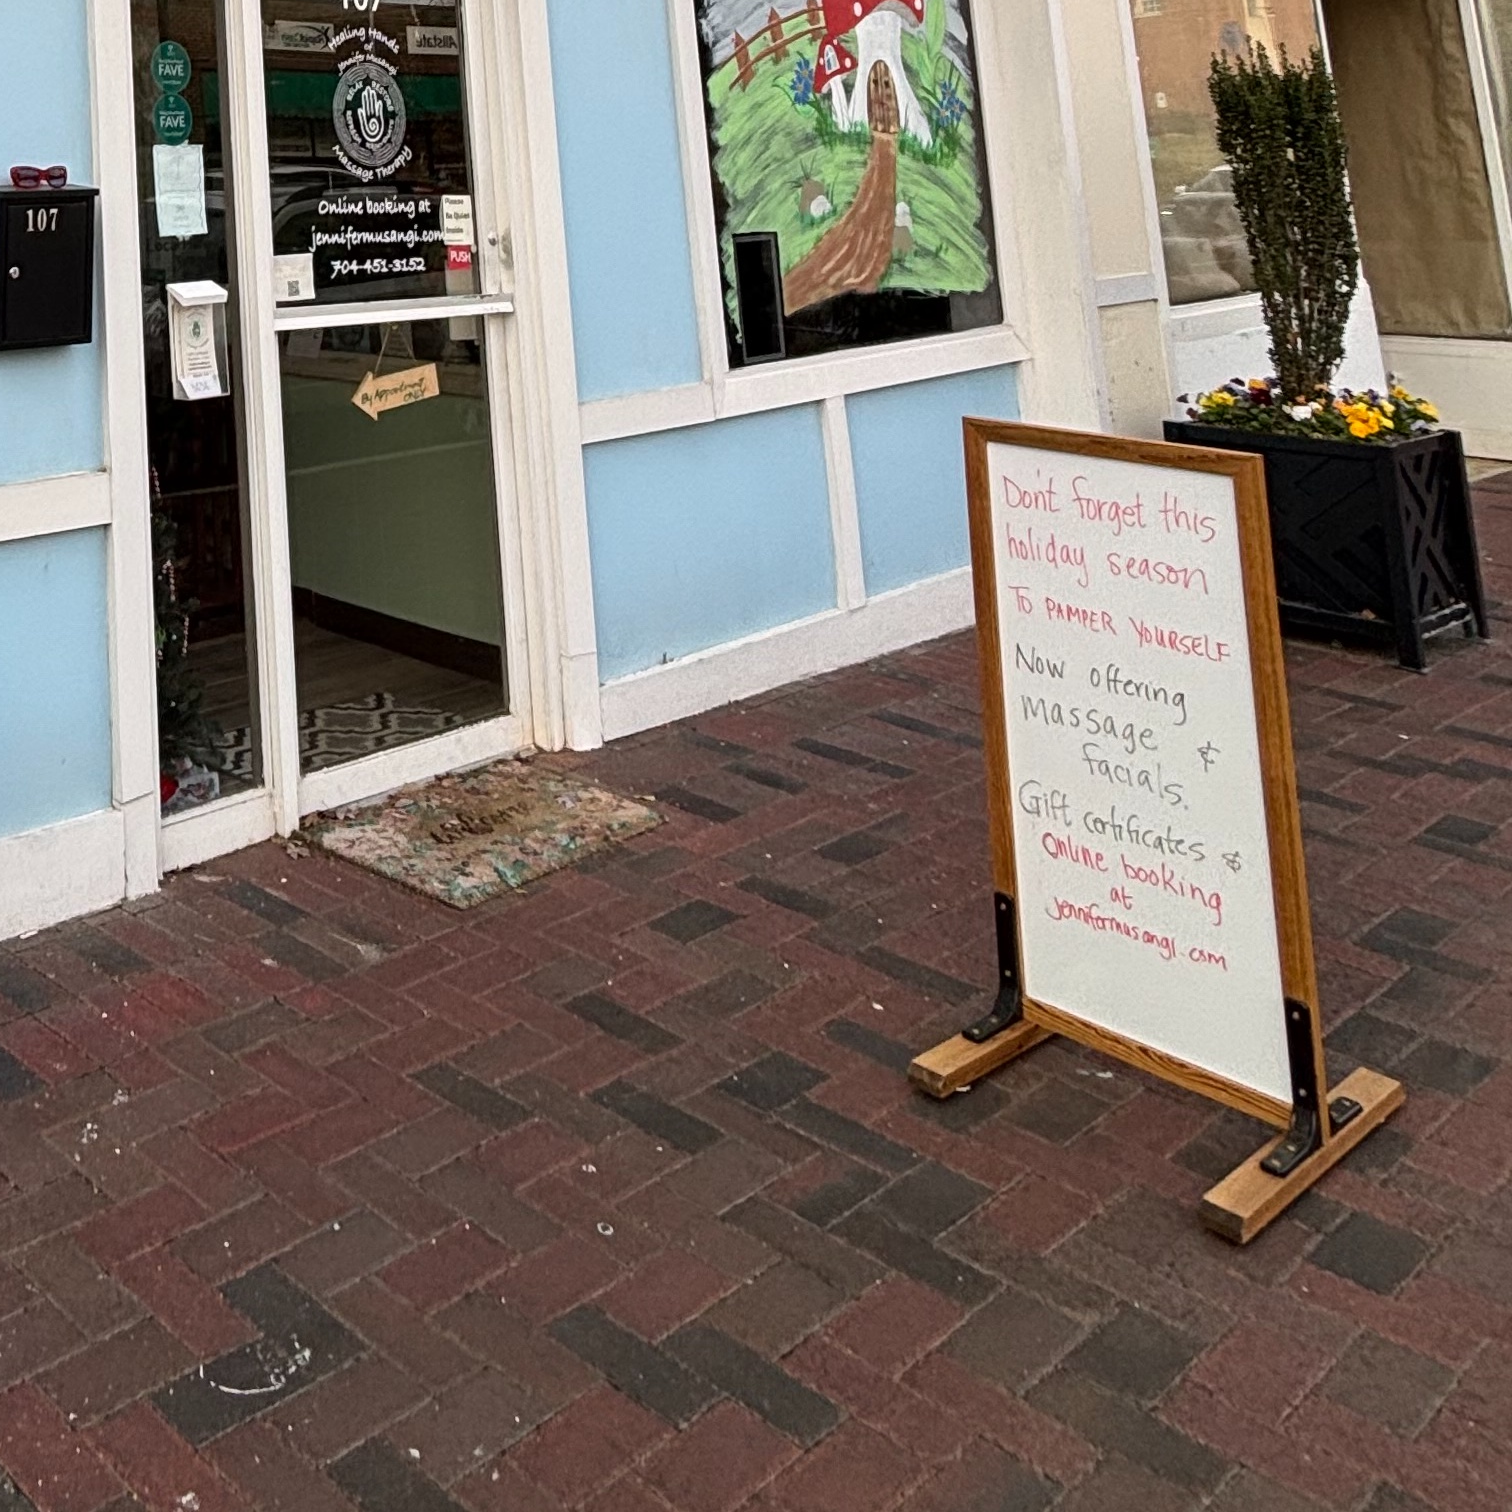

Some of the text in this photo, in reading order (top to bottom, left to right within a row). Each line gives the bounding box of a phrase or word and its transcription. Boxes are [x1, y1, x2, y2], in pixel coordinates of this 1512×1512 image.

[327, 24, 366, 51] Healing
[368, 26, 400, 55] Hands
[363, 40, 375, 52] of
[158, 63, 184, 77] FAVE
[159, 115, 186, 128] FAVE
[332, 144, 413, 183] Massage Therapy
[317, 194, 431, 219] Online booking at
[26, 207, 59, 233] 107
[308, 223, 445, 253] jennifermusangi.com
[329, 256, 427, 280] 704-451-3152
[450, 250, 472, 264] PUSH
[361, 393, 373, 407] By
[403, 387, 426, 403] ONLY
[1003, 469, 1216, 543] Don't forget this
[1006, 522, 1209, 595] holiday season
[1045, 596, 1118, 636] PAMPER
[1128, 616, 1231, 662] YOURSELF
[1015, 642, 1066, 680] Now
[1018, 779, 1072, 827] Gift
[1082, 804, 1207, 862] certificates
[1041, 831, 1223, 927] Online booking
[1109, 885, 1134, 911] at
